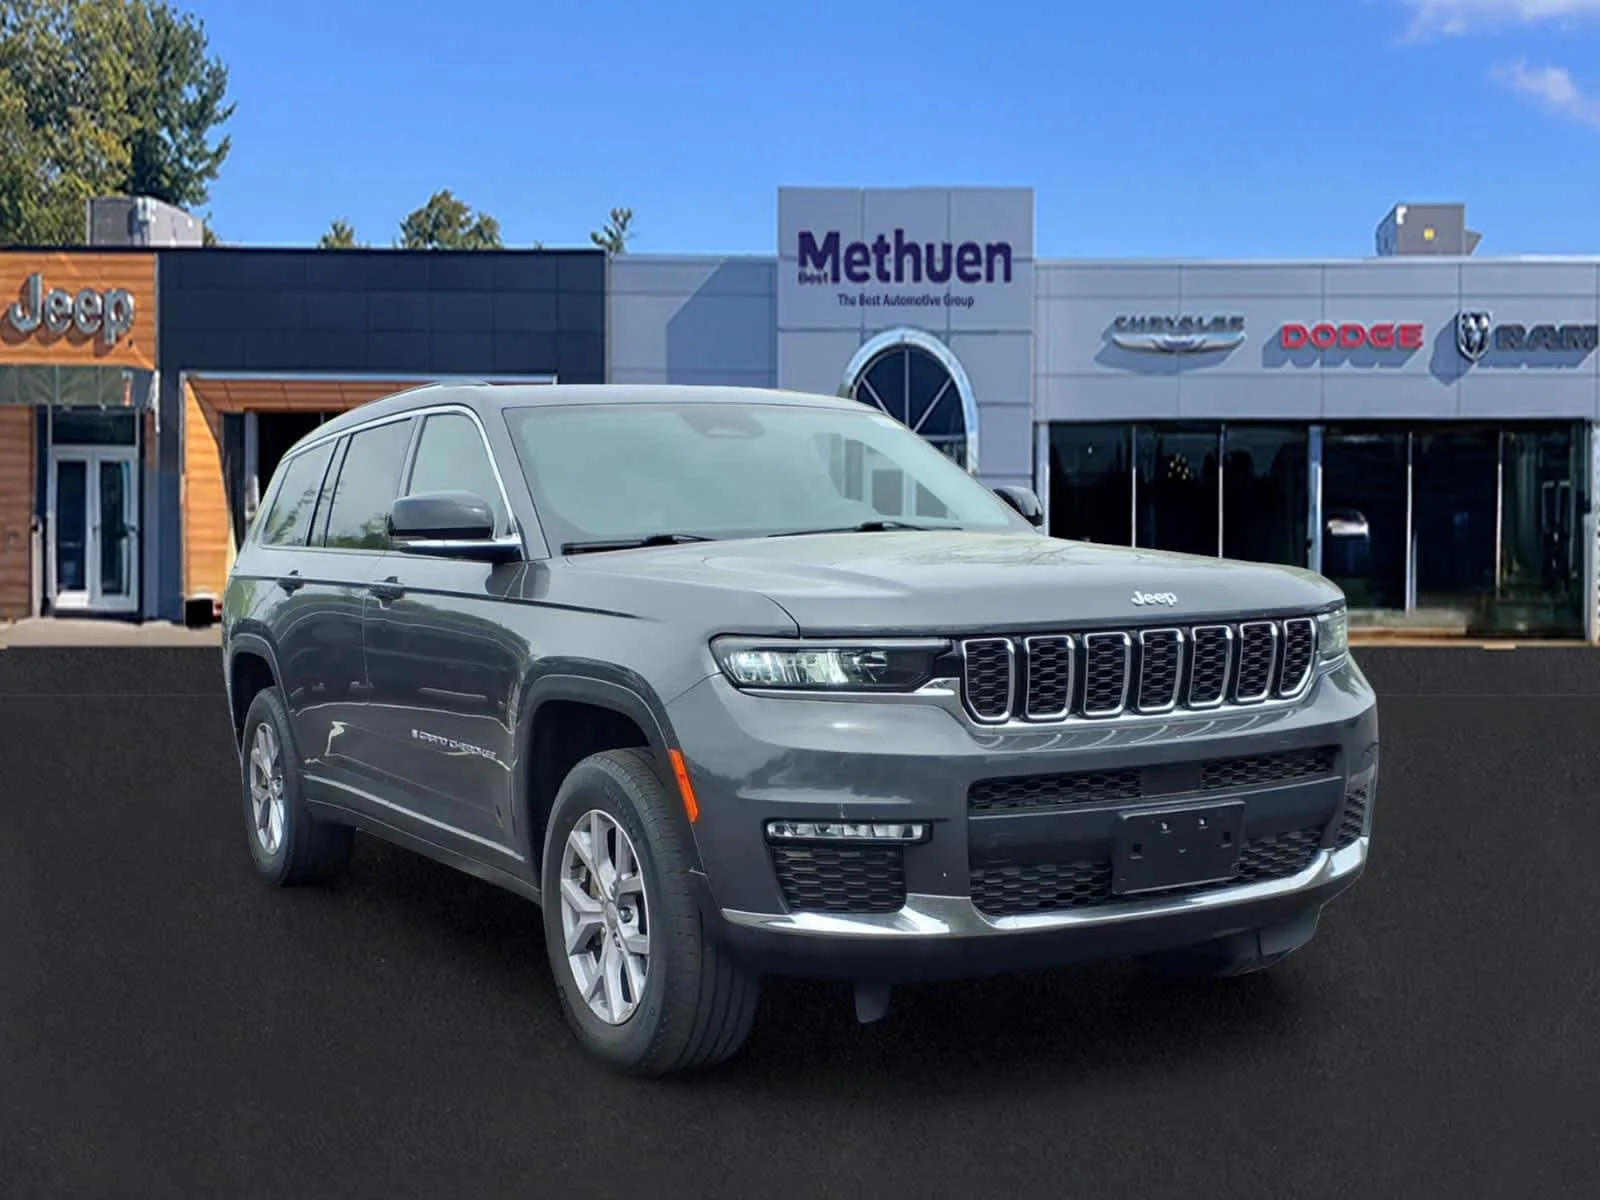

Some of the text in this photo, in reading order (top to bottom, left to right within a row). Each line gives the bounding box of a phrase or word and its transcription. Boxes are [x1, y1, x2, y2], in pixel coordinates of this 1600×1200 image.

[798, 229, 1012, 283] Methuen
[798, 272, 829, 284] Best
[9, 273, 135, 344] Jeep
[838, 294, 975, 308] The Best Automotive Group
[1281, 323, 1424, 349] DODGE
[1495, 324, 1599, 350] RAM
[1130, 590, 1178, 608] Jeep
